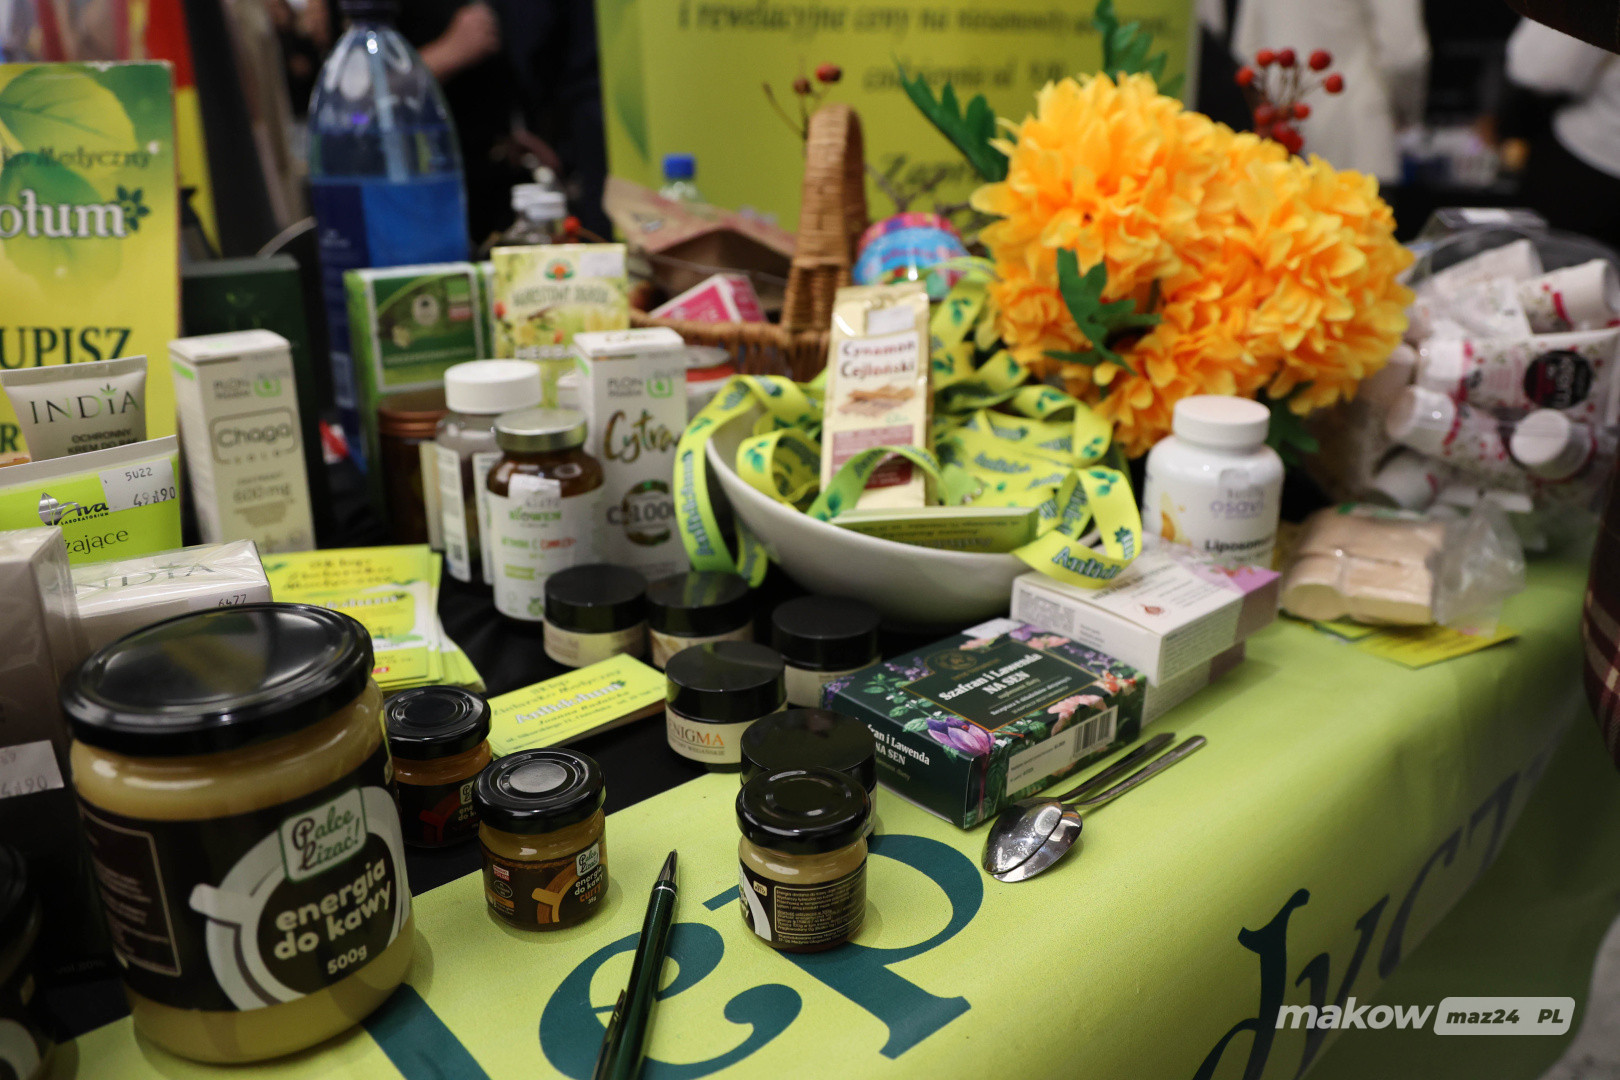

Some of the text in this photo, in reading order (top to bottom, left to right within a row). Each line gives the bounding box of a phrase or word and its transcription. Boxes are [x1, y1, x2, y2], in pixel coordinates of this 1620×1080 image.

[938, 676, 990, 701] Szafran
[982, 672, 996, 681] i
[989, 652, 1043, 679] Lawenda
[981, 670, 1031, 695] NA SEN
[887, 749, 906, 766] SEN
[891, 737, 930, 766] Lawenda
[275, 857, 387, 932] energia
[574, 885, 586, 897] do
[273, 880, 392, 961] do kawy
[326, 944, 368, 975] 500g
